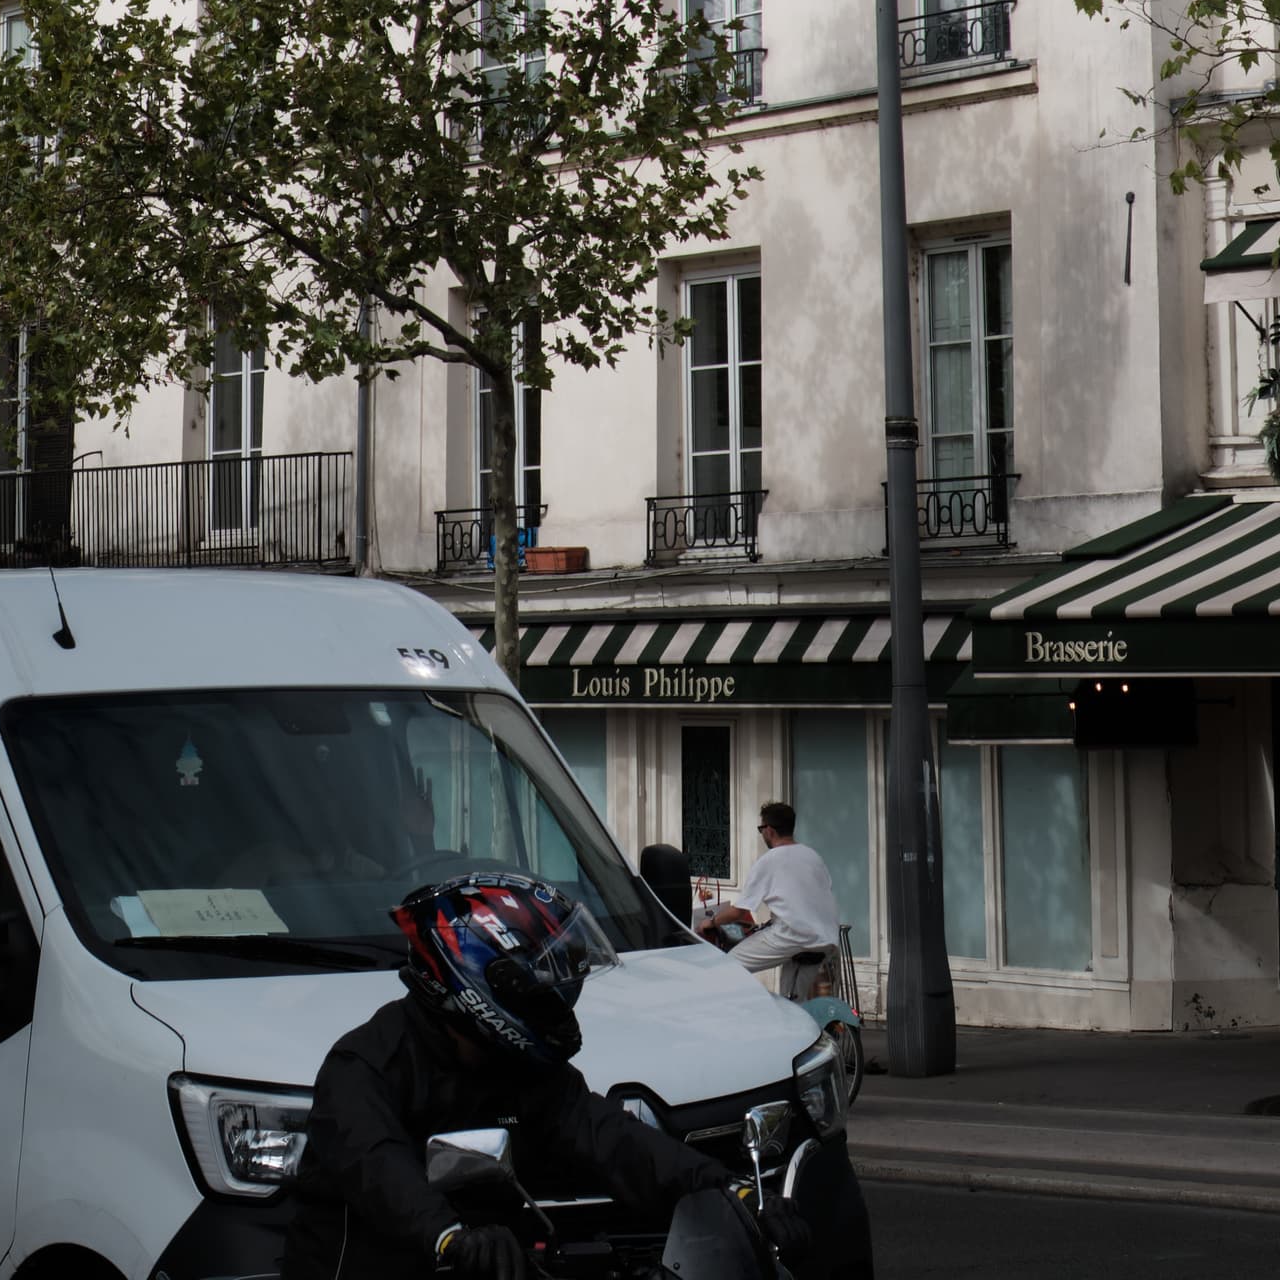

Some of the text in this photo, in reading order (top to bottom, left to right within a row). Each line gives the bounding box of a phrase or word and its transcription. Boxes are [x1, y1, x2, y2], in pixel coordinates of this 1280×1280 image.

[397, 647, 450, 669] 559
[1024, 629, 1128, 662] Brasserie
[572, 668, 736, 703] Louis Philippe
[462, 988, 536, 1051] SHARK
